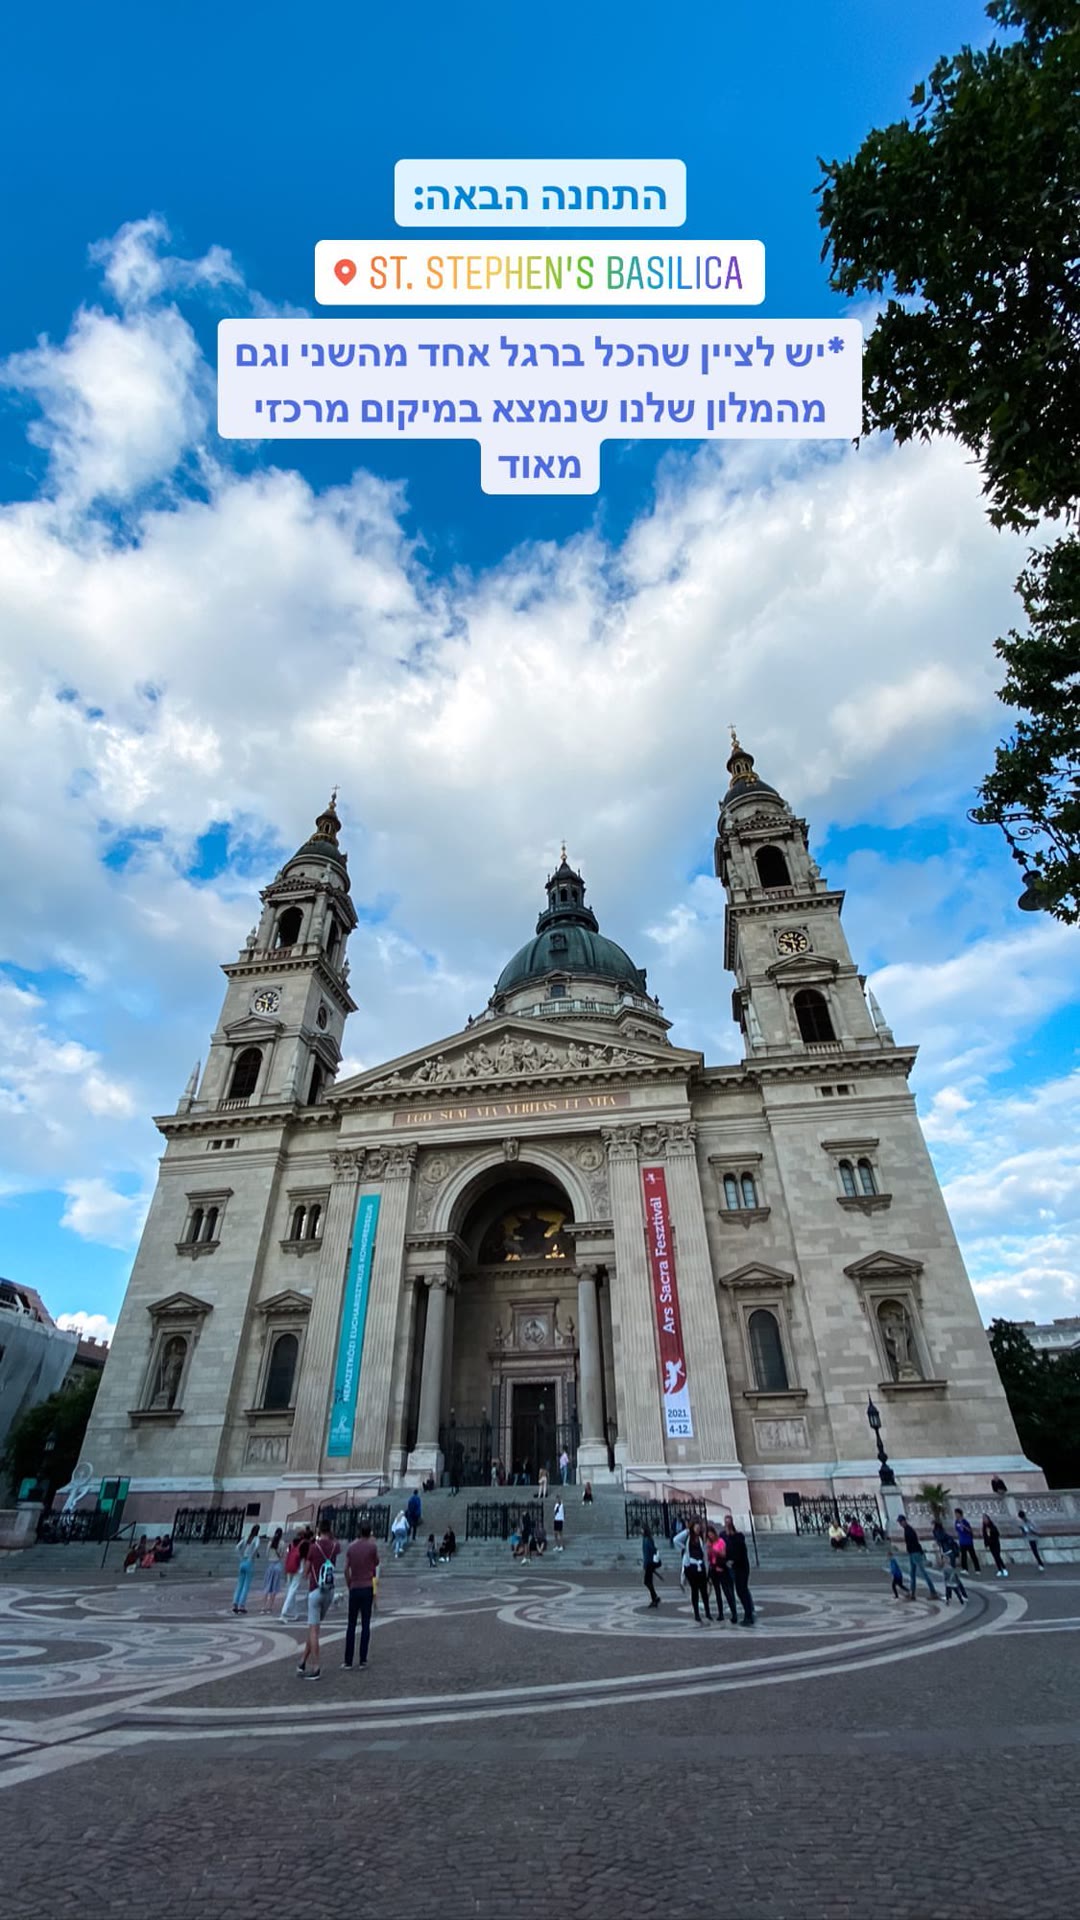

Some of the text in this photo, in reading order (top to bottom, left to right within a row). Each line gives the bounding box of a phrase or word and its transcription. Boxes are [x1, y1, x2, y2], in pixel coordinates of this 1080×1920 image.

[650, 1196, 676, 1334] Ars Sacra Fesztivál
